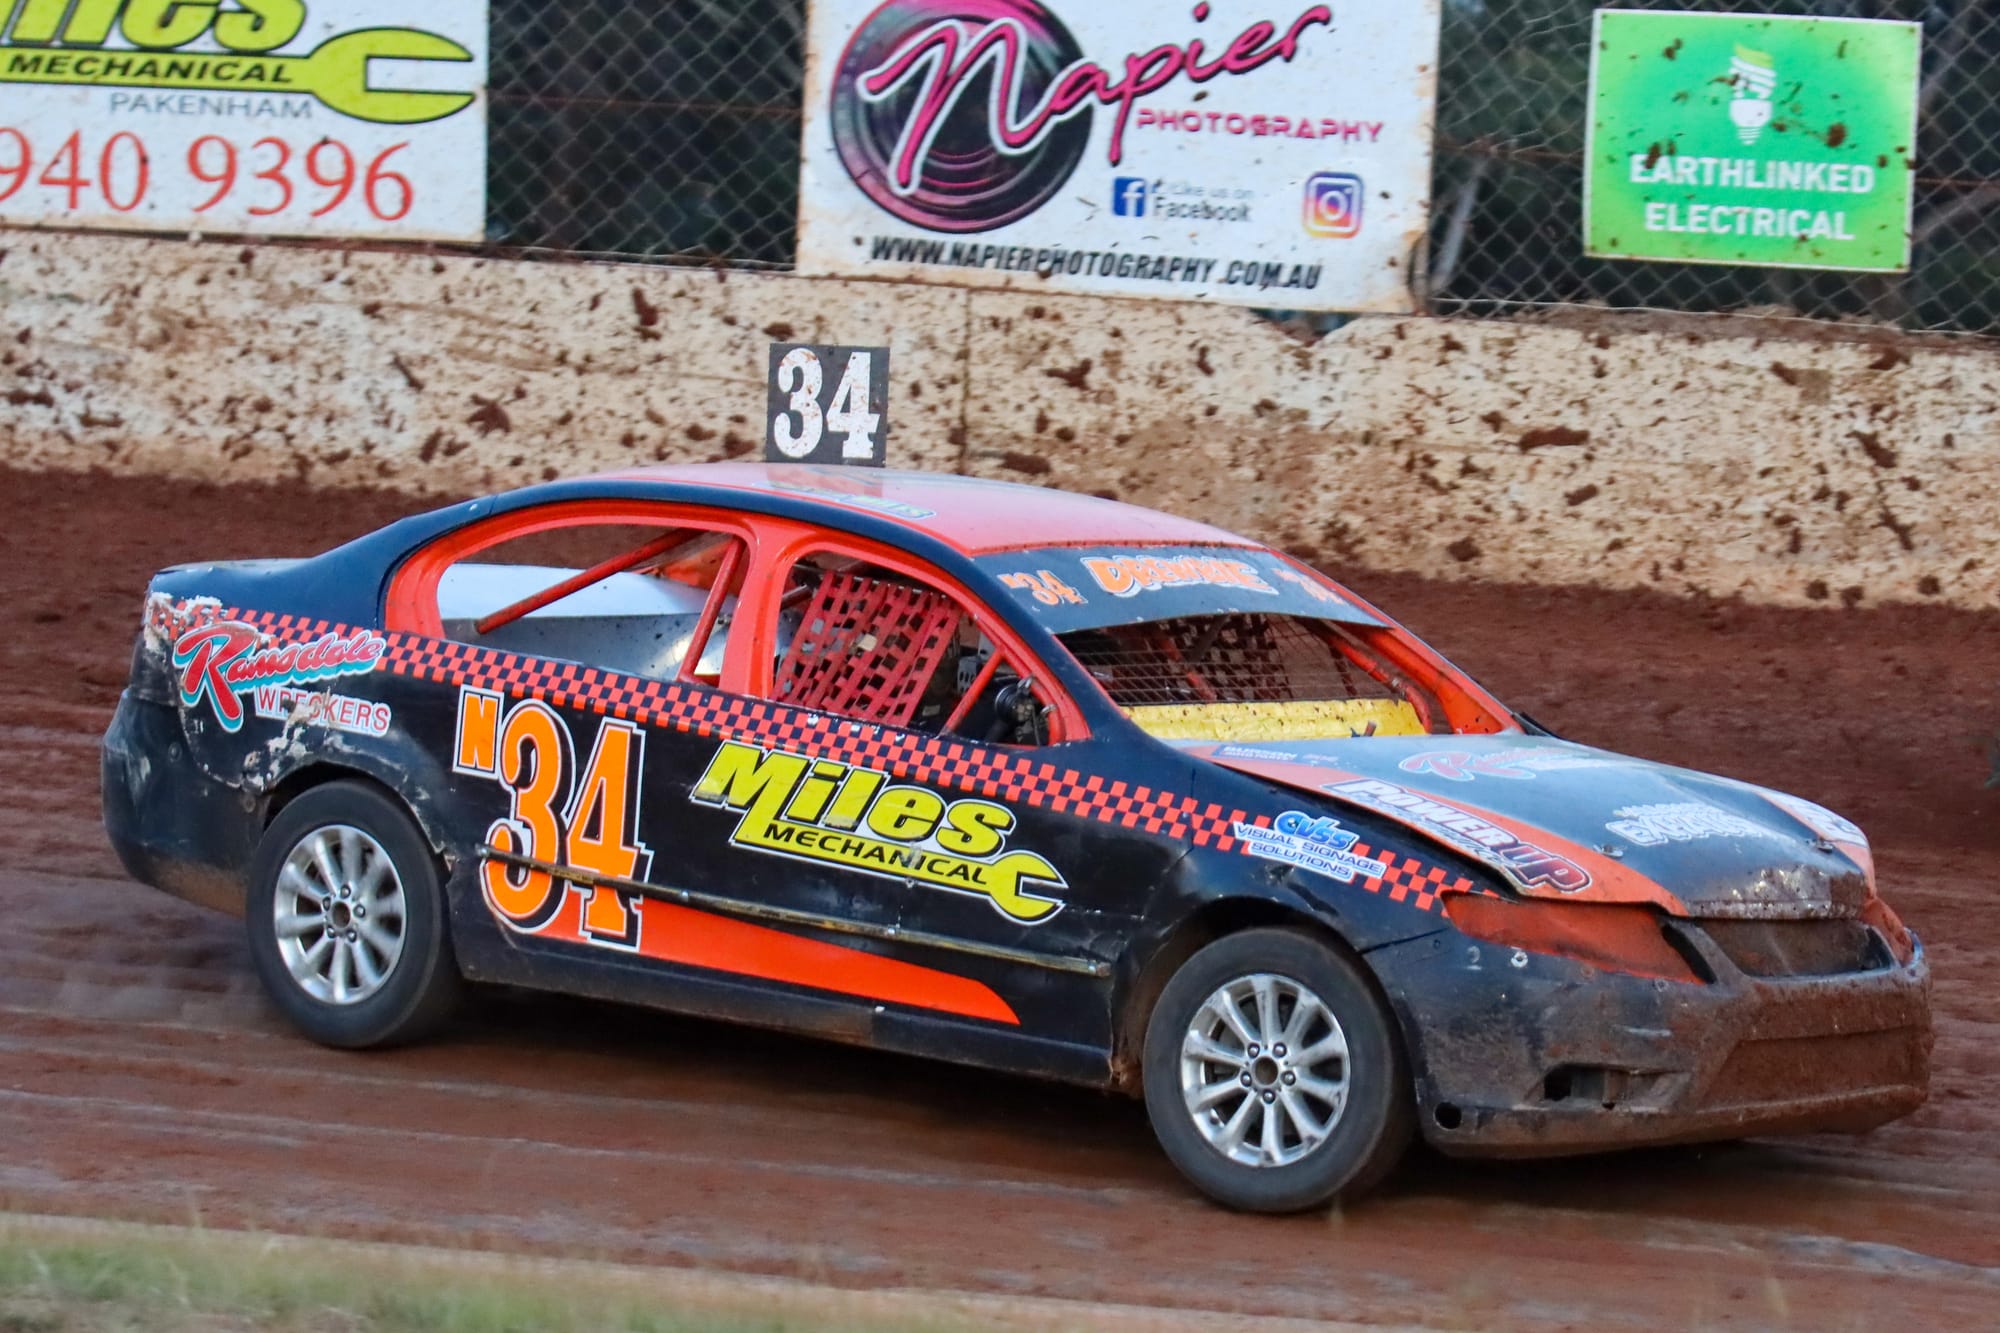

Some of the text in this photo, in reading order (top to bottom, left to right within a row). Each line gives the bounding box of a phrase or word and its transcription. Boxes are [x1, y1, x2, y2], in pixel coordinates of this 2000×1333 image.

[8, 54, 293, 83] MECHANICAL
[110, 92, 313, 119] PAKENHAM
[862, 3, 1332, 190] Napier
[1136, 108, 1384, 143] PHOTOGRAPHY
[187, 135, 413, 221] 9396
[1630, 154, 1875, 193] EARTHLINKED
[1152, 195, 1252, 223] Facebook
[1645, 202, 1855, 240] ELECTRICAL
[774, 347, 880, 459] 34
[174, 622, 386, 728] Ramsdale
[692, 742, 1016, 858] Miles
[764, 823, 988, 886] MECHANICAL
[1235, 824, 1383, 873] VISUAL SIGNAGE
[1250, 841, 1350, 876] SOLUTIONS
